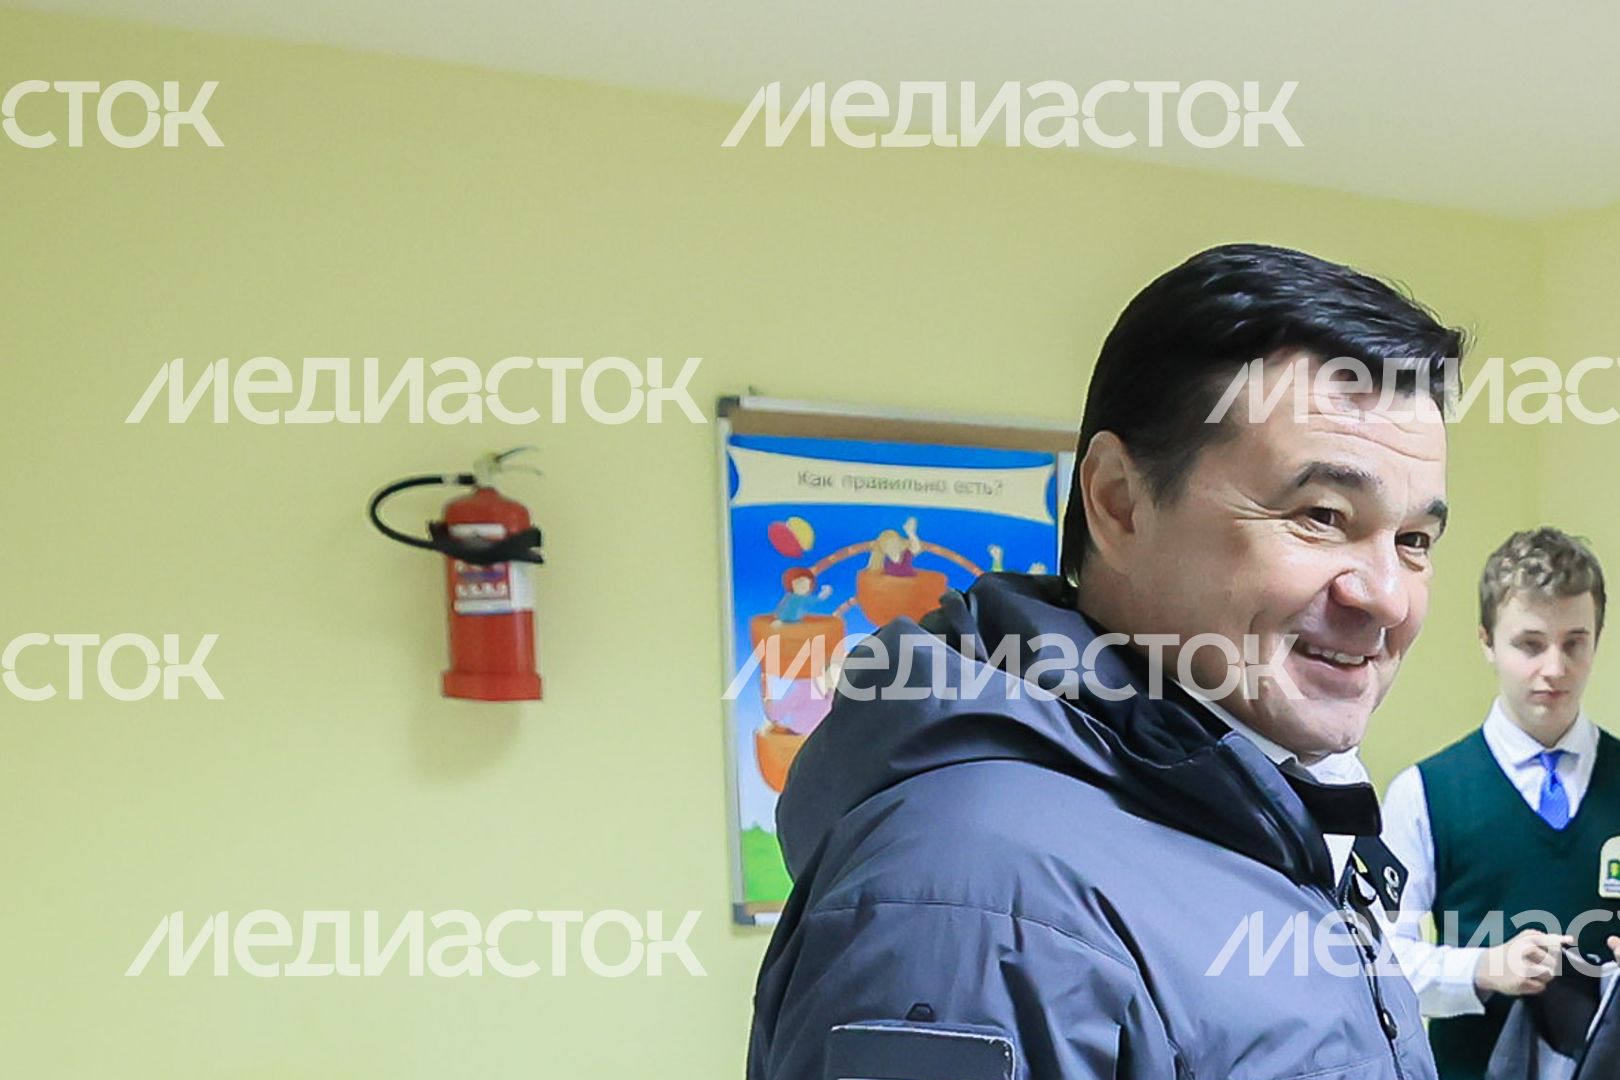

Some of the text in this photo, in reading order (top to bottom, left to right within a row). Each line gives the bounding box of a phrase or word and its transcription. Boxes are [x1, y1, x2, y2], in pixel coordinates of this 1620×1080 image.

[797, 470, 1004, 497] Как правильно есть?
